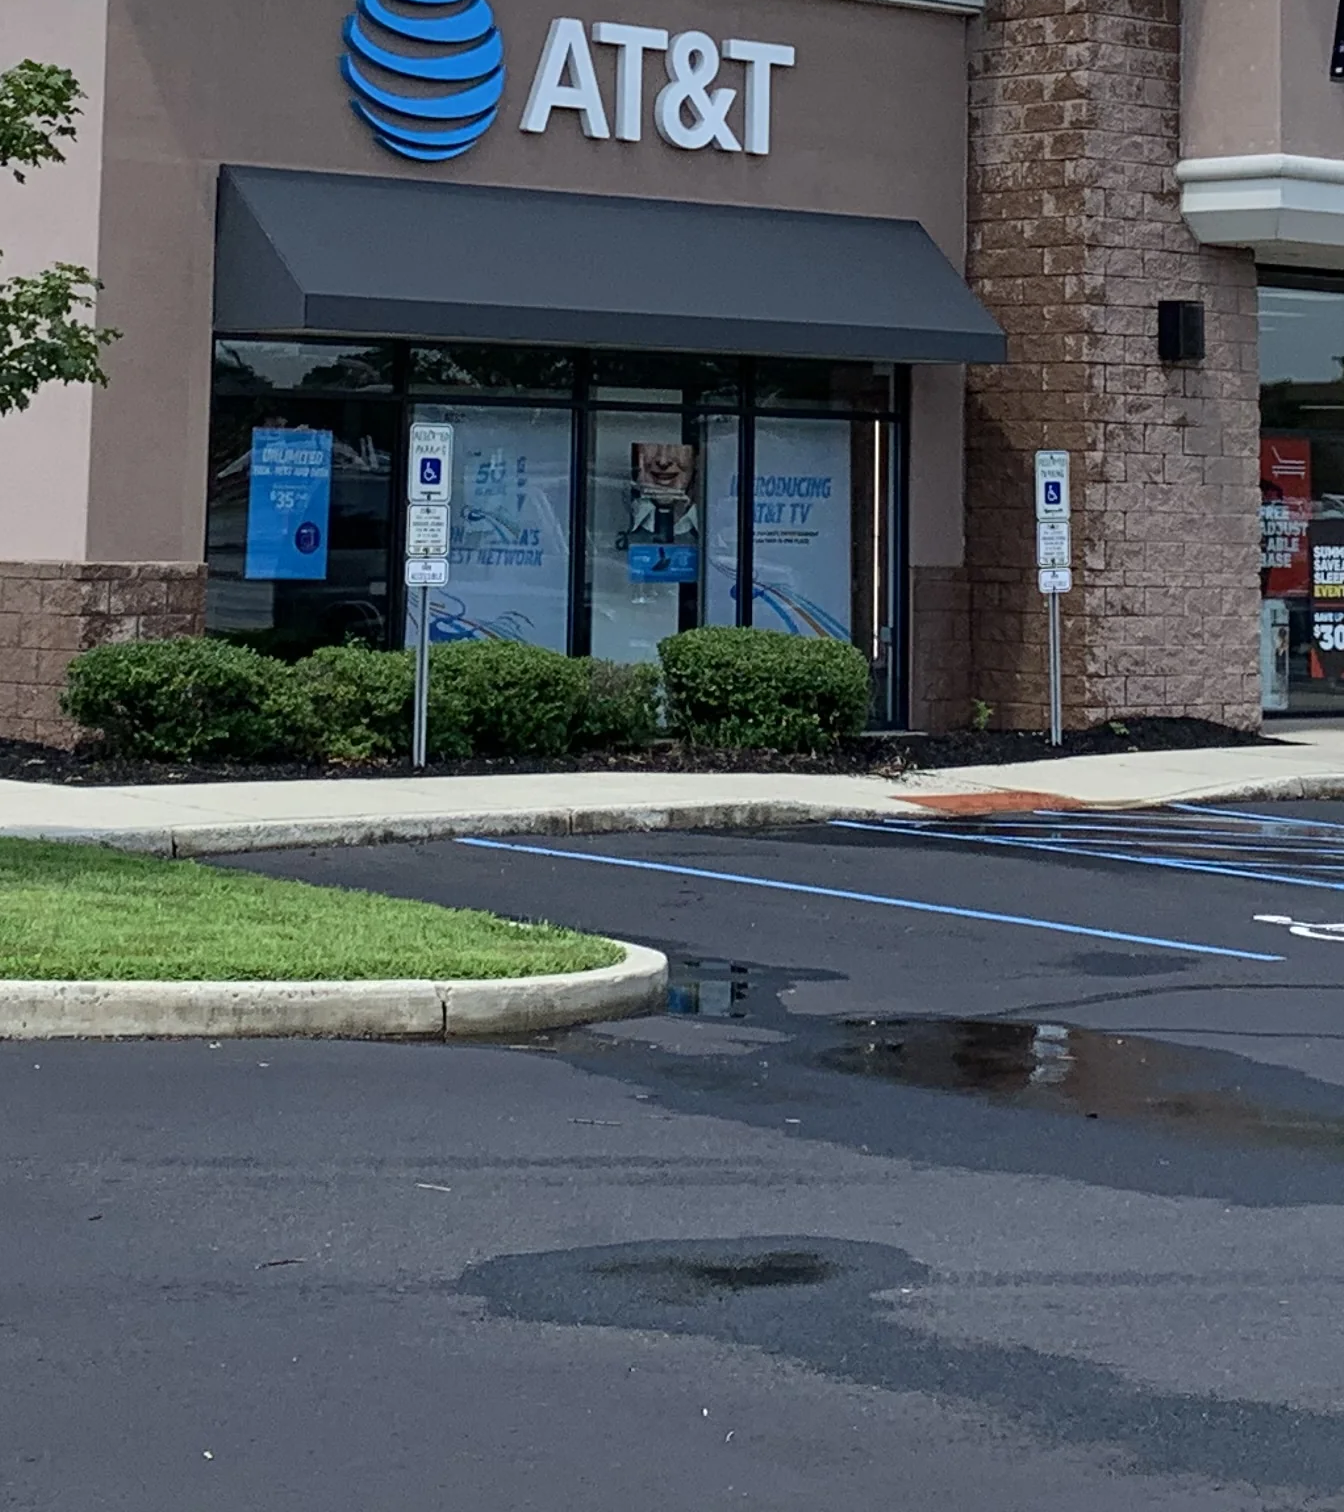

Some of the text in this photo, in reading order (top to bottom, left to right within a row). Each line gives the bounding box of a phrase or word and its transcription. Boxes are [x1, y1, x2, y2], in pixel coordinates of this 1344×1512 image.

[519, 17, 795, 155] AT&T
[730, 474, 832, 499] IRODUCING
[754, 502, 787, 525] T&T
